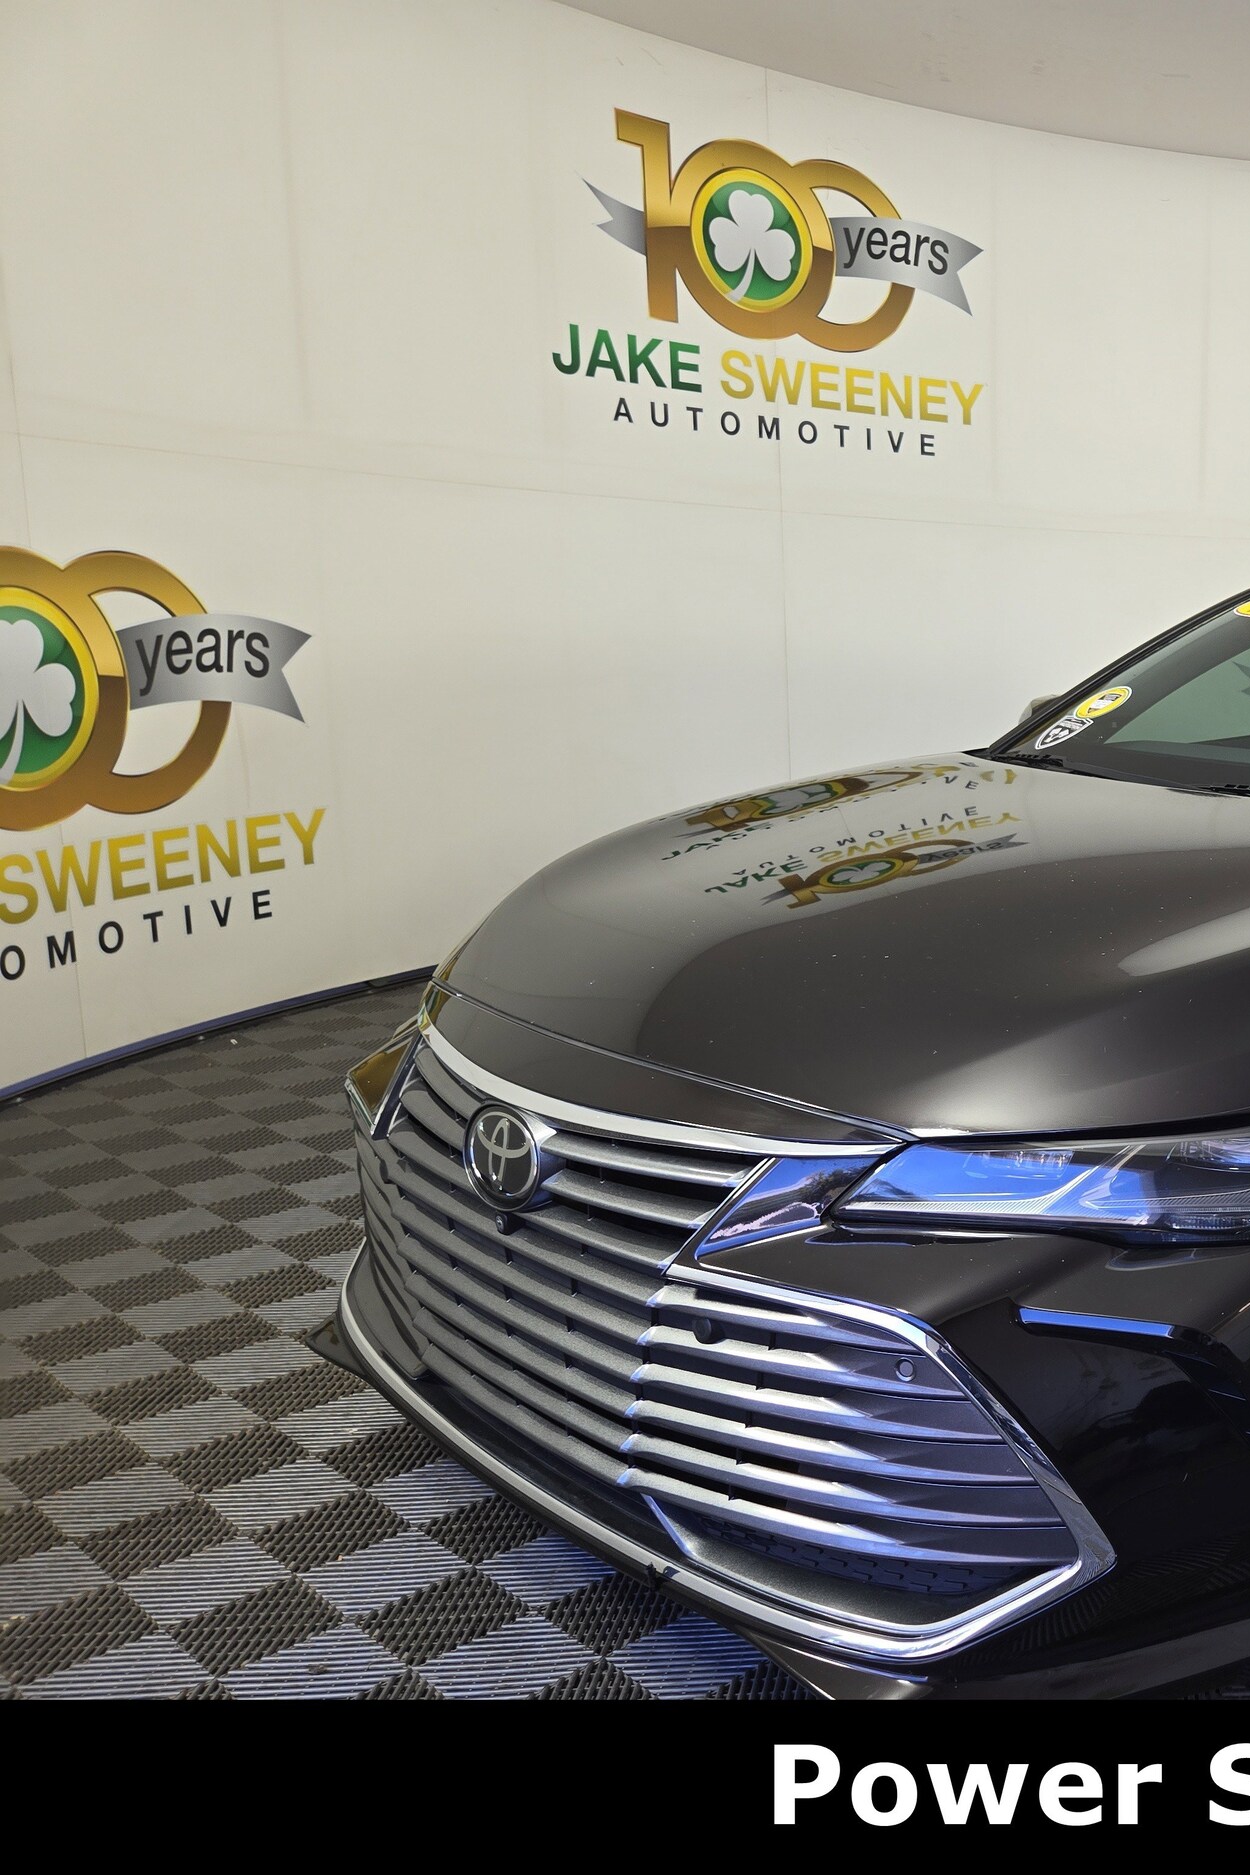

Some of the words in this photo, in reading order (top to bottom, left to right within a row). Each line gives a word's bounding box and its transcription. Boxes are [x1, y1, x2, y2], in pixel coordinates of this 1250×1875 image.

[614, 107, 916, 352] 100
[843, 225, 950, 276] years
[552, 322, 702, 393] JAKE
[720, 349, 983, 426] SWEENEY
[613, 396, 936, 457] AUTOMOTIVE
[0, 546, 232, 832] 00
[135, 628, 271, 697] years
[0, 808, 326, 925] SWEENEY
[0, 889, 273, 981] OMOTIVE
